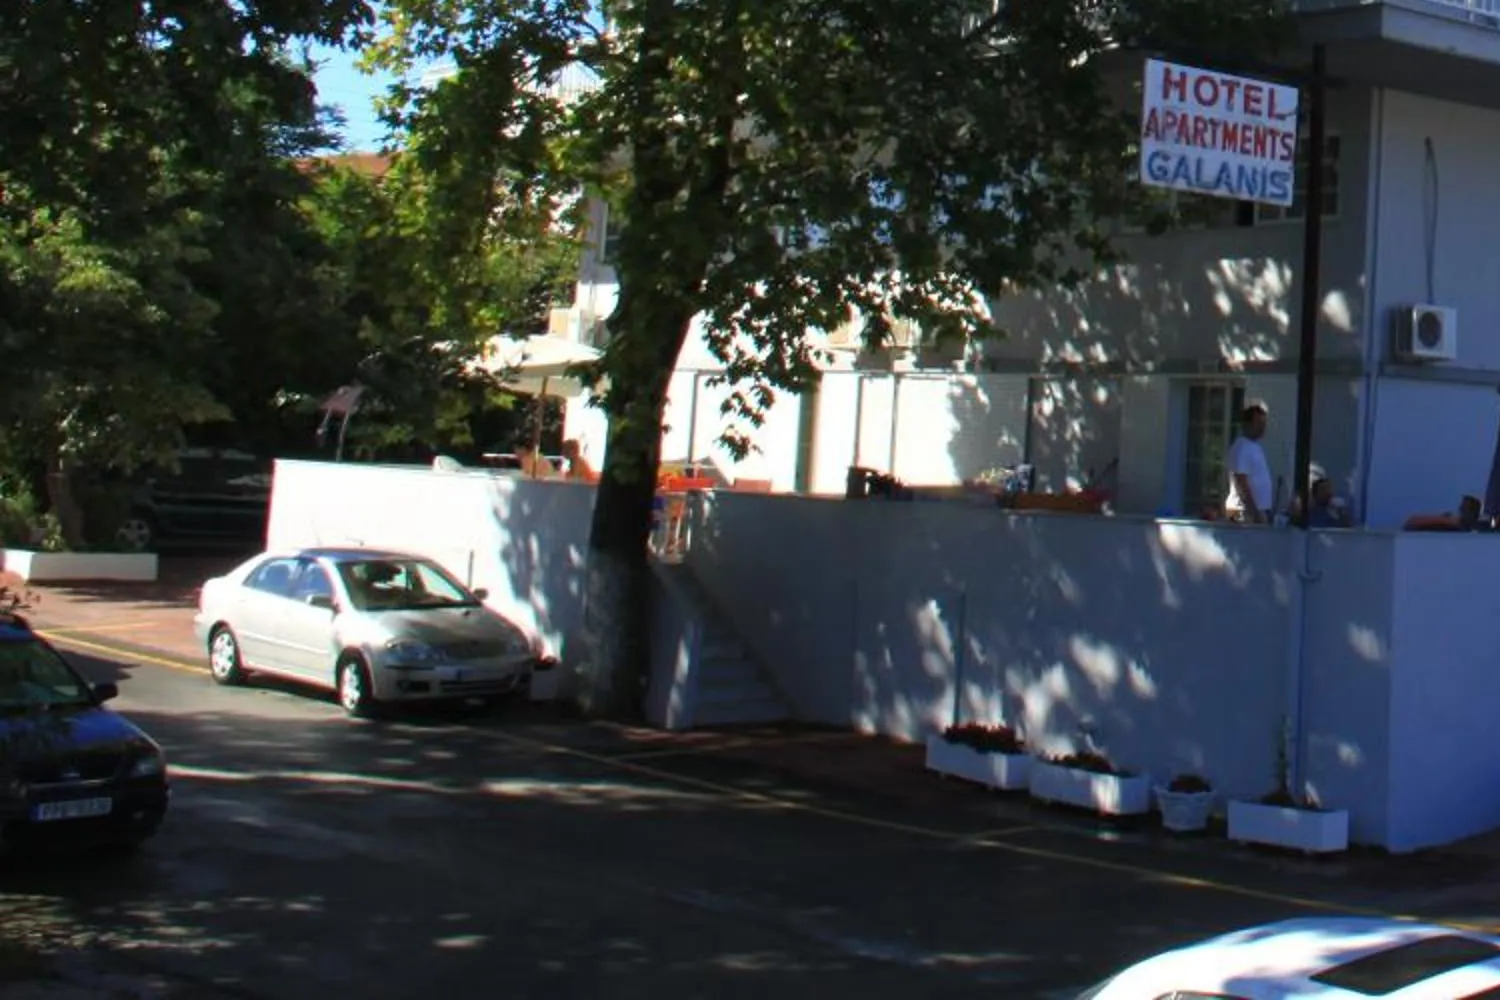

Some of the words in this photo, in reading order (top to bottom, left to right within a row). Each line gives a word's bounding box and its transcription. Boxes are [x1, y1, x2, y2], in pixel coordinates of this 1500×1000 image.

[1162, 67, 1289, 120] HOTEL
[1144, 106, 1293, 161] APARTMENTS
[1147, 150, 1291, 199] GALANIS
